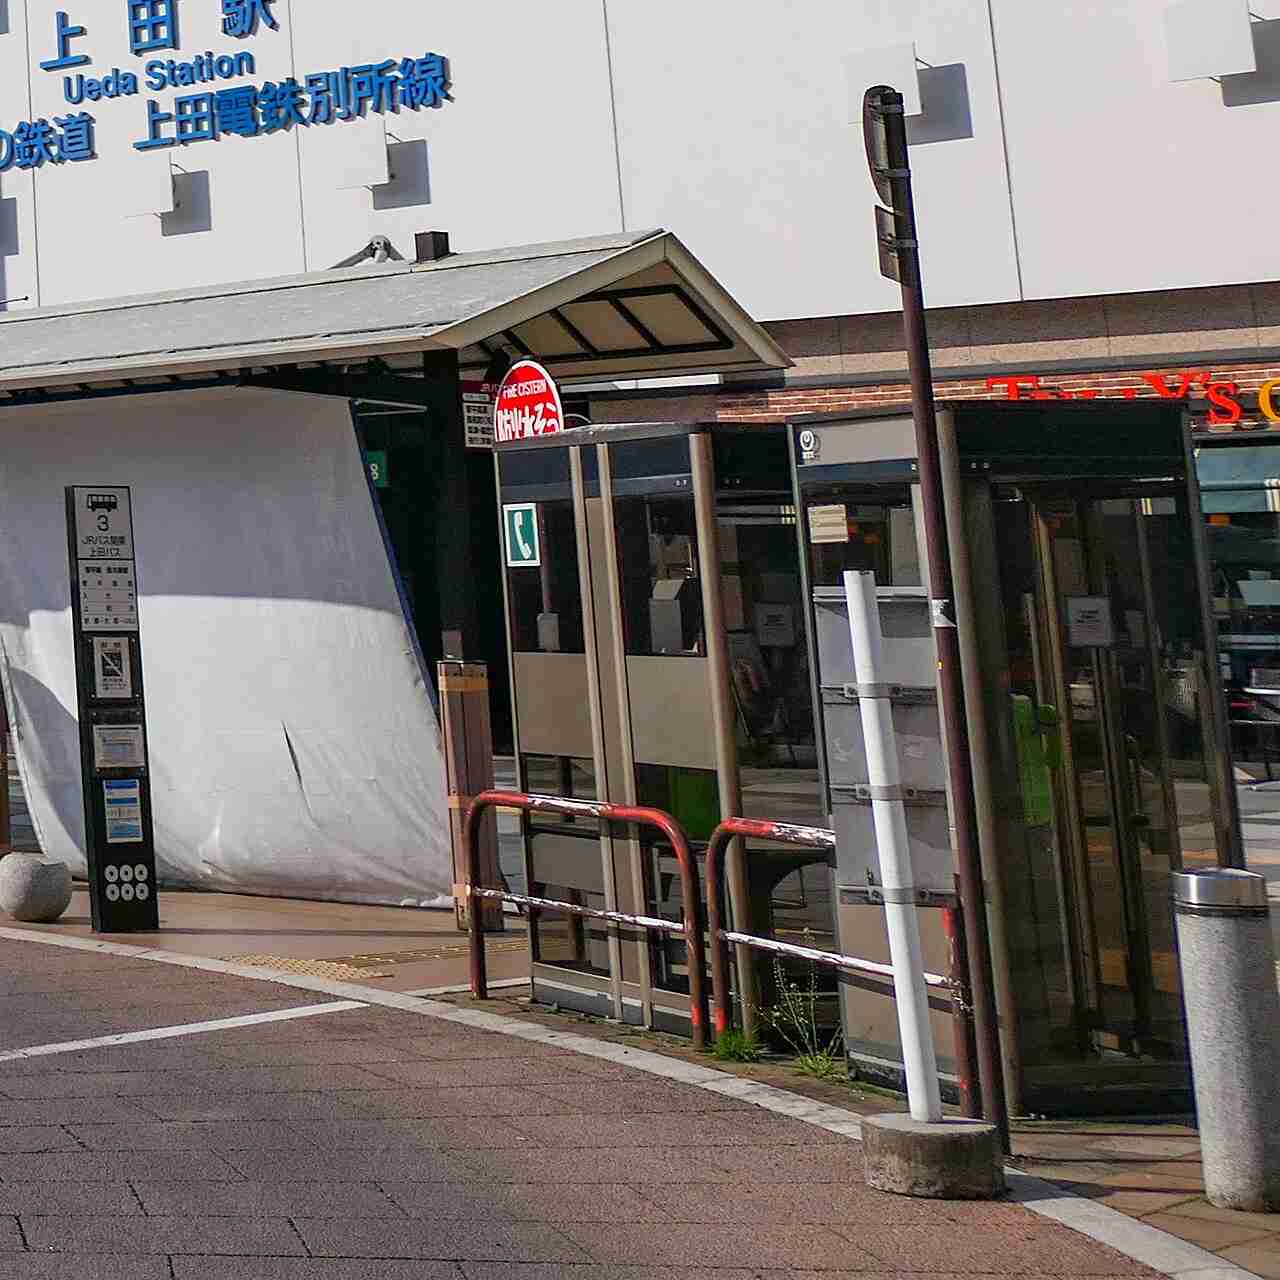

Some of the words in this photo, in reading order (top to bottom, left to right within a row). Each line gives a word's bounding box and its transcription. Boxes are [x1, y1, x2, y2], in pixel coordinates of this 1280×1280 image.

[64, 68, 139, 105] Ueda
[145, 51, 256, 91] Station
[132, 52, 454, 152] 上田電鉄別所線
[96, 514, 110, 532] 3
